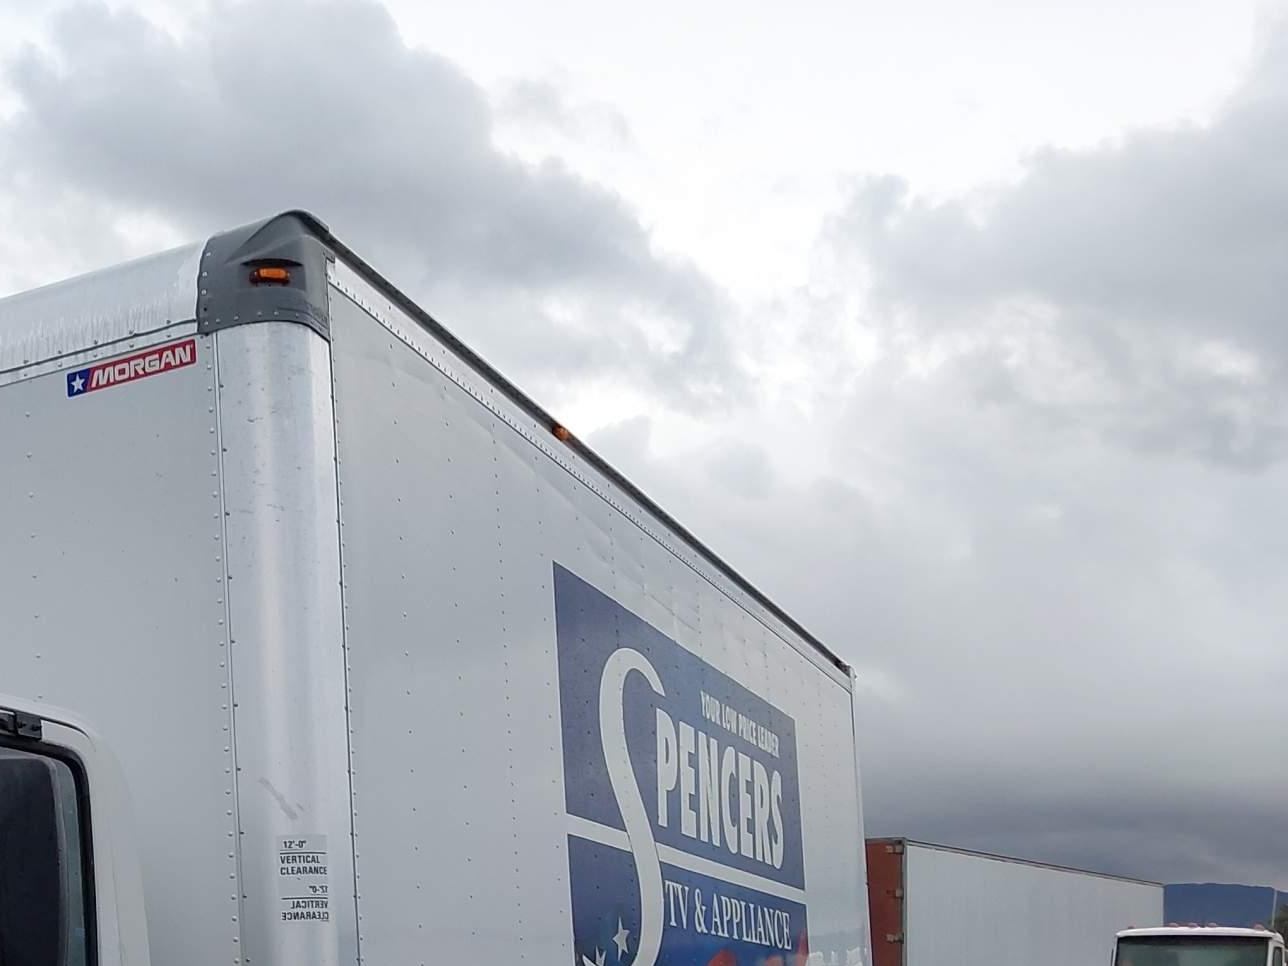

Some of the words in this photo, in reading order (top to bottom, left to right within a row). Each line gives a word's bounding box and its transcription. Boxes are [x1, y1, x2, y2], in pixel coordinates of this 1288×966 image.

[90, 344, 192, 388] MORGAN
[700, 689, 721, 726] YOUR
[721, 703, 737, 736] LOW
[738, 713, 758, 747] PRICE
[758, 726, 779, 758] LEADER
[280, 855, 321, 864] VERTICAL
[280, 866, 328, 876] CLEARANCE
[664, 880, 690, 930] TV
[694, 897, 708, 936] &
[710, 893, 792, 951] APPLIANCE
